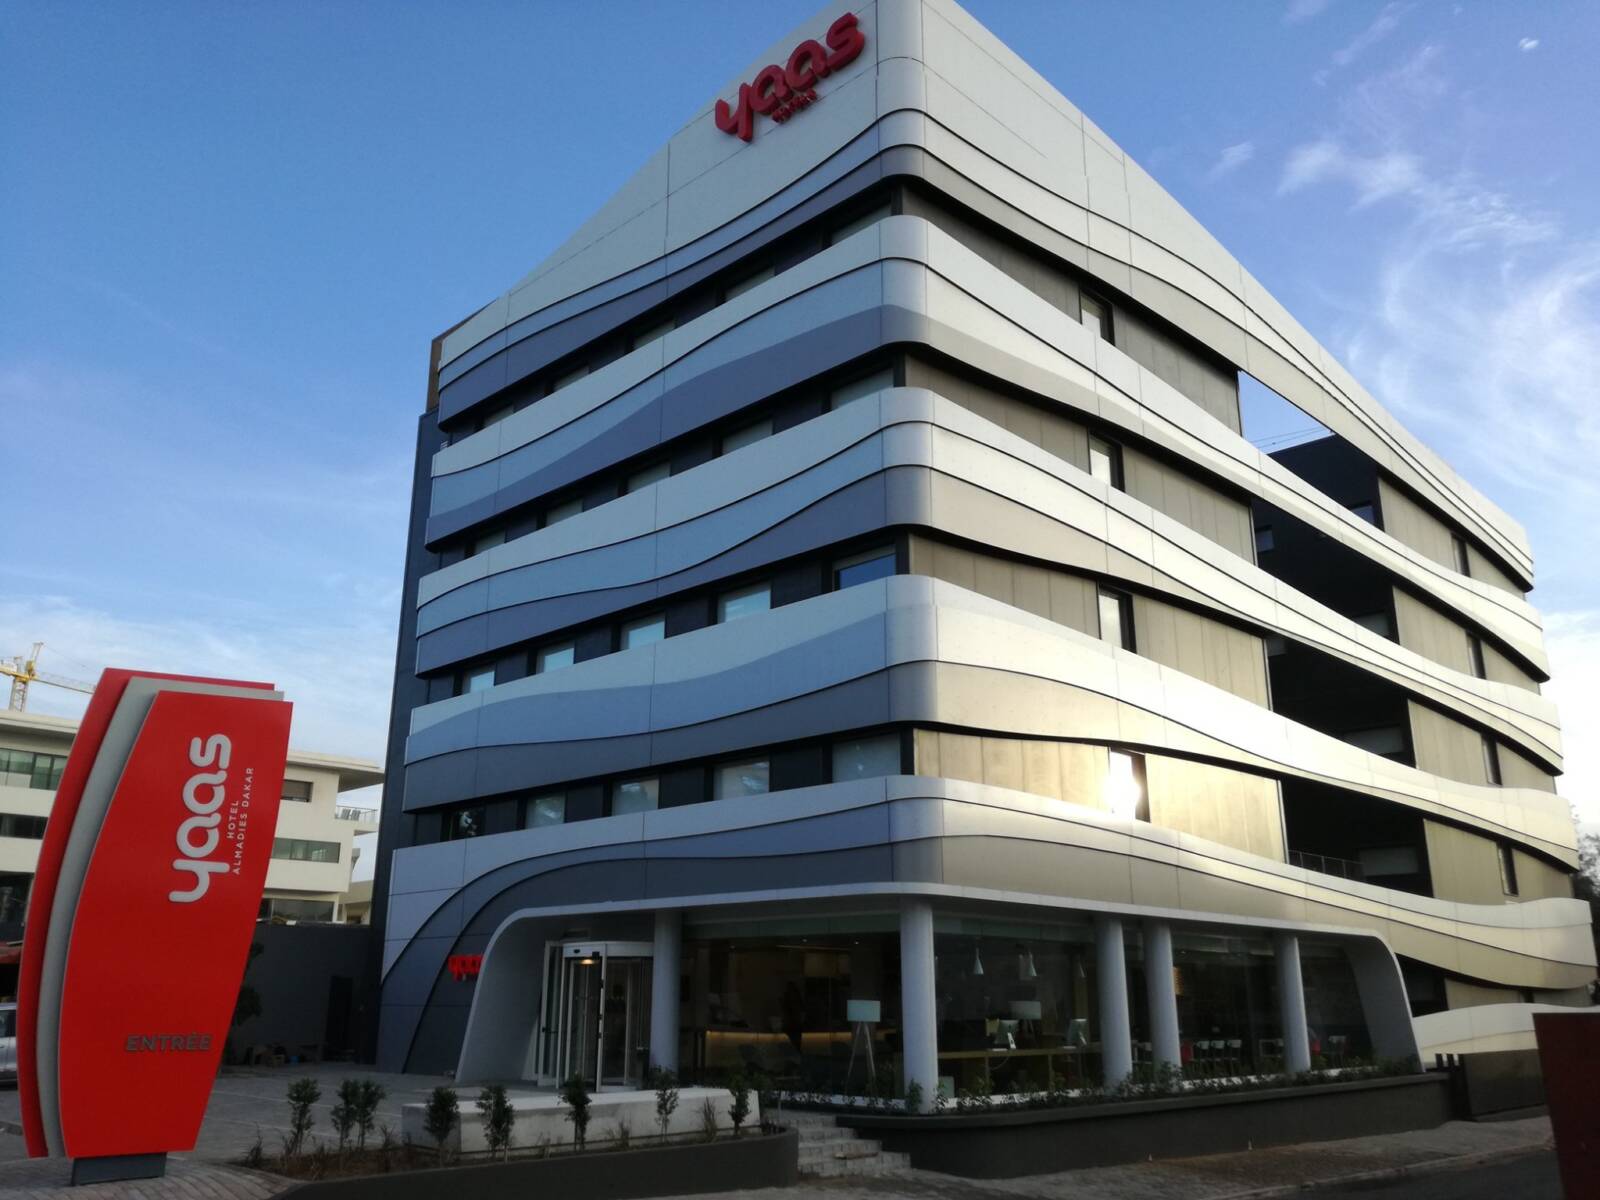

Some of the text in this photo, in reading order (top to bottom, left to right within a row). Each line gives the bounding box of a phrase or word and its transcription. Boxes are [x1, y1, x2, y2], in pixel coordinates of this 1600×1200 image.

[714, 12, 865, 142] yaas
[168, 733, 232, 902] yaas
[227, 800, 238, 839] HOTEL
[233, 767, 254, 875] ALMADIES DAKAR
